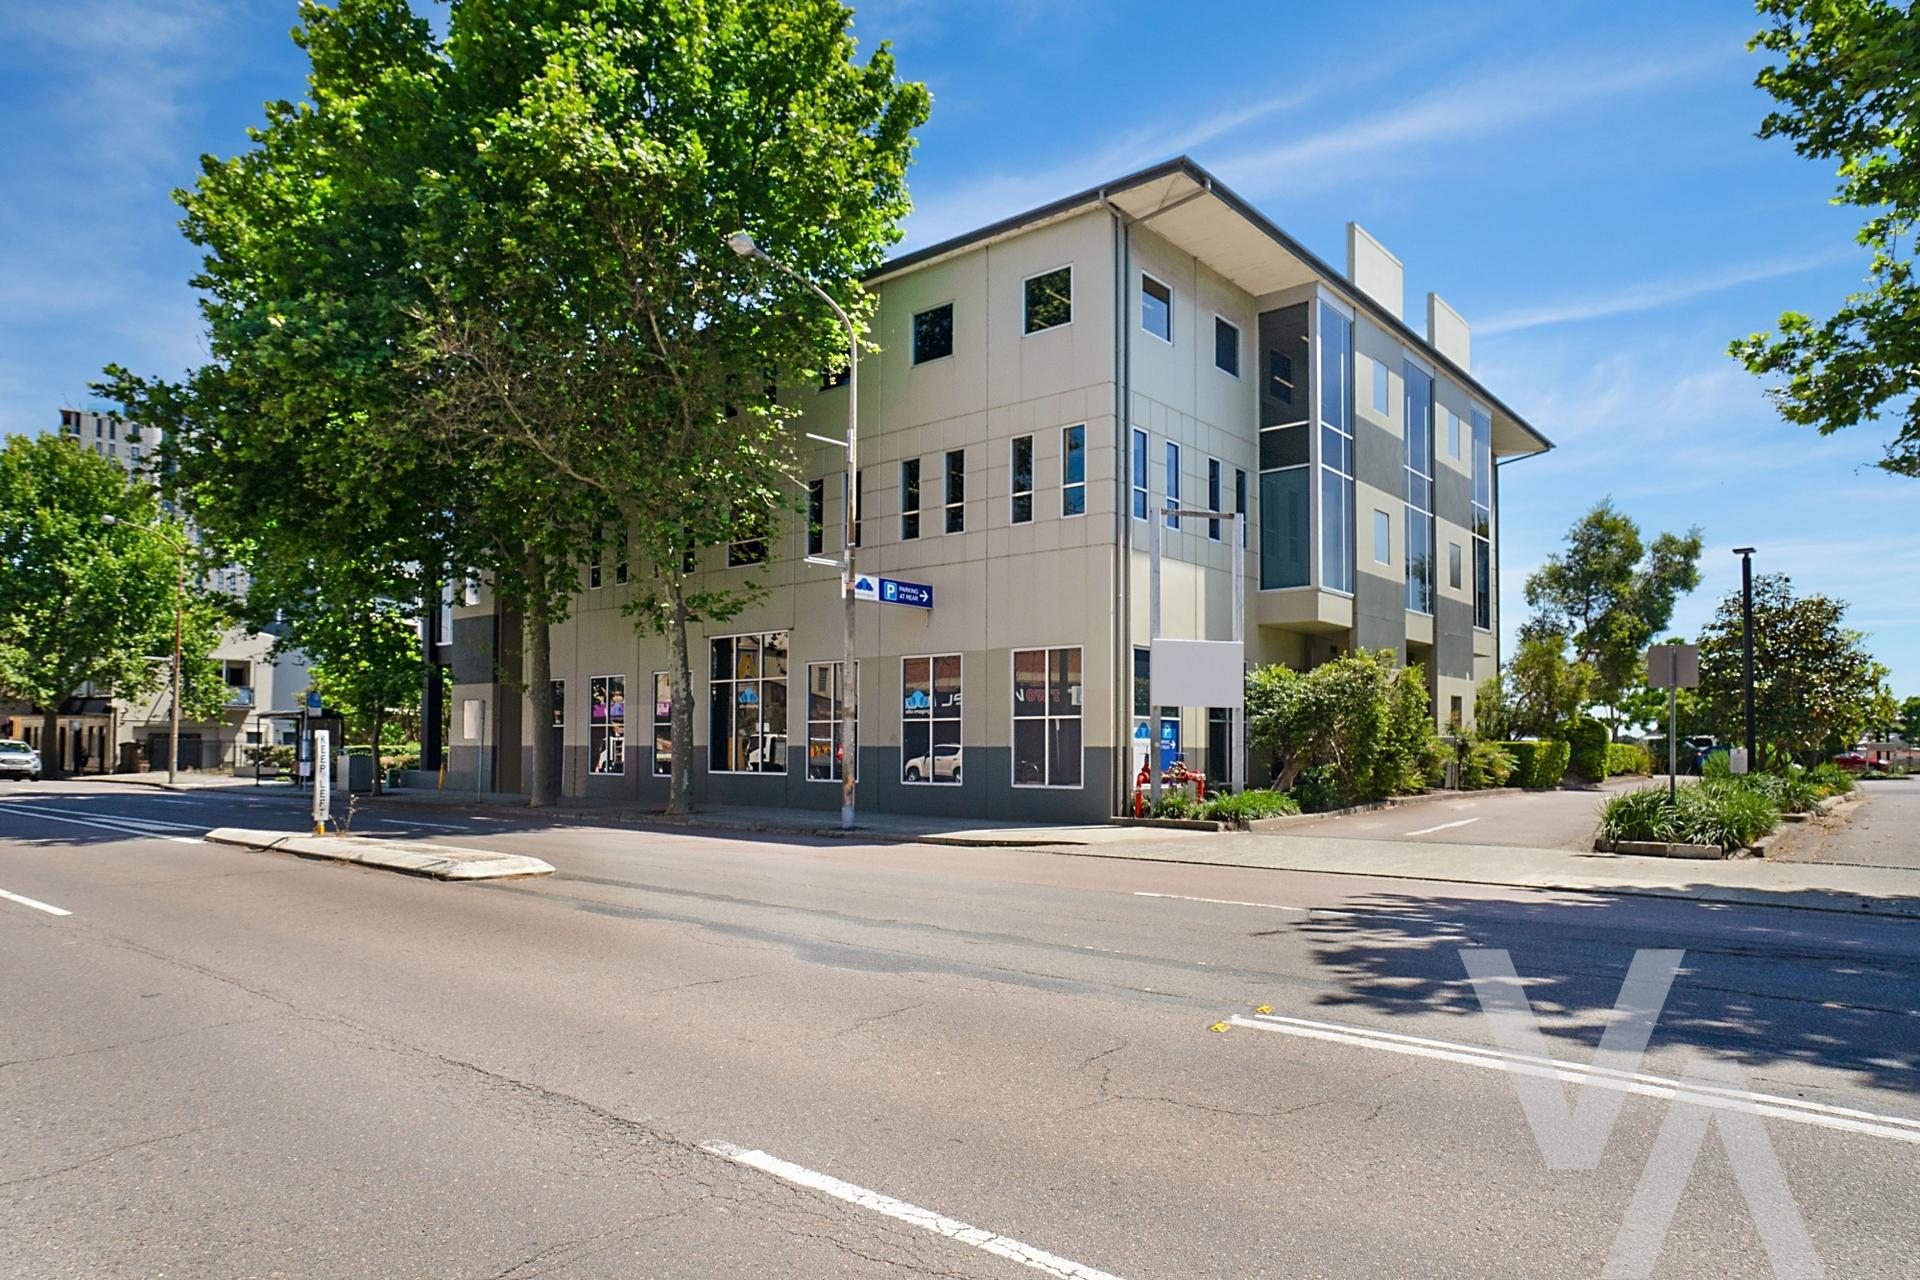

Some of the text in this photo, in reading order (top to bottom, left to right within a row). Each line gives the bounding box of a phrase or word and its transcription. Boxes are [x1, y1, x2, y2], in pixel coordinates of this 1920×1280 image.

[887, 584, 895, 598] P
[899, 586, 919, 595] PARKING
[906, 594, 919, 602] REAR
[319, 735, 327, 773] KEEP
